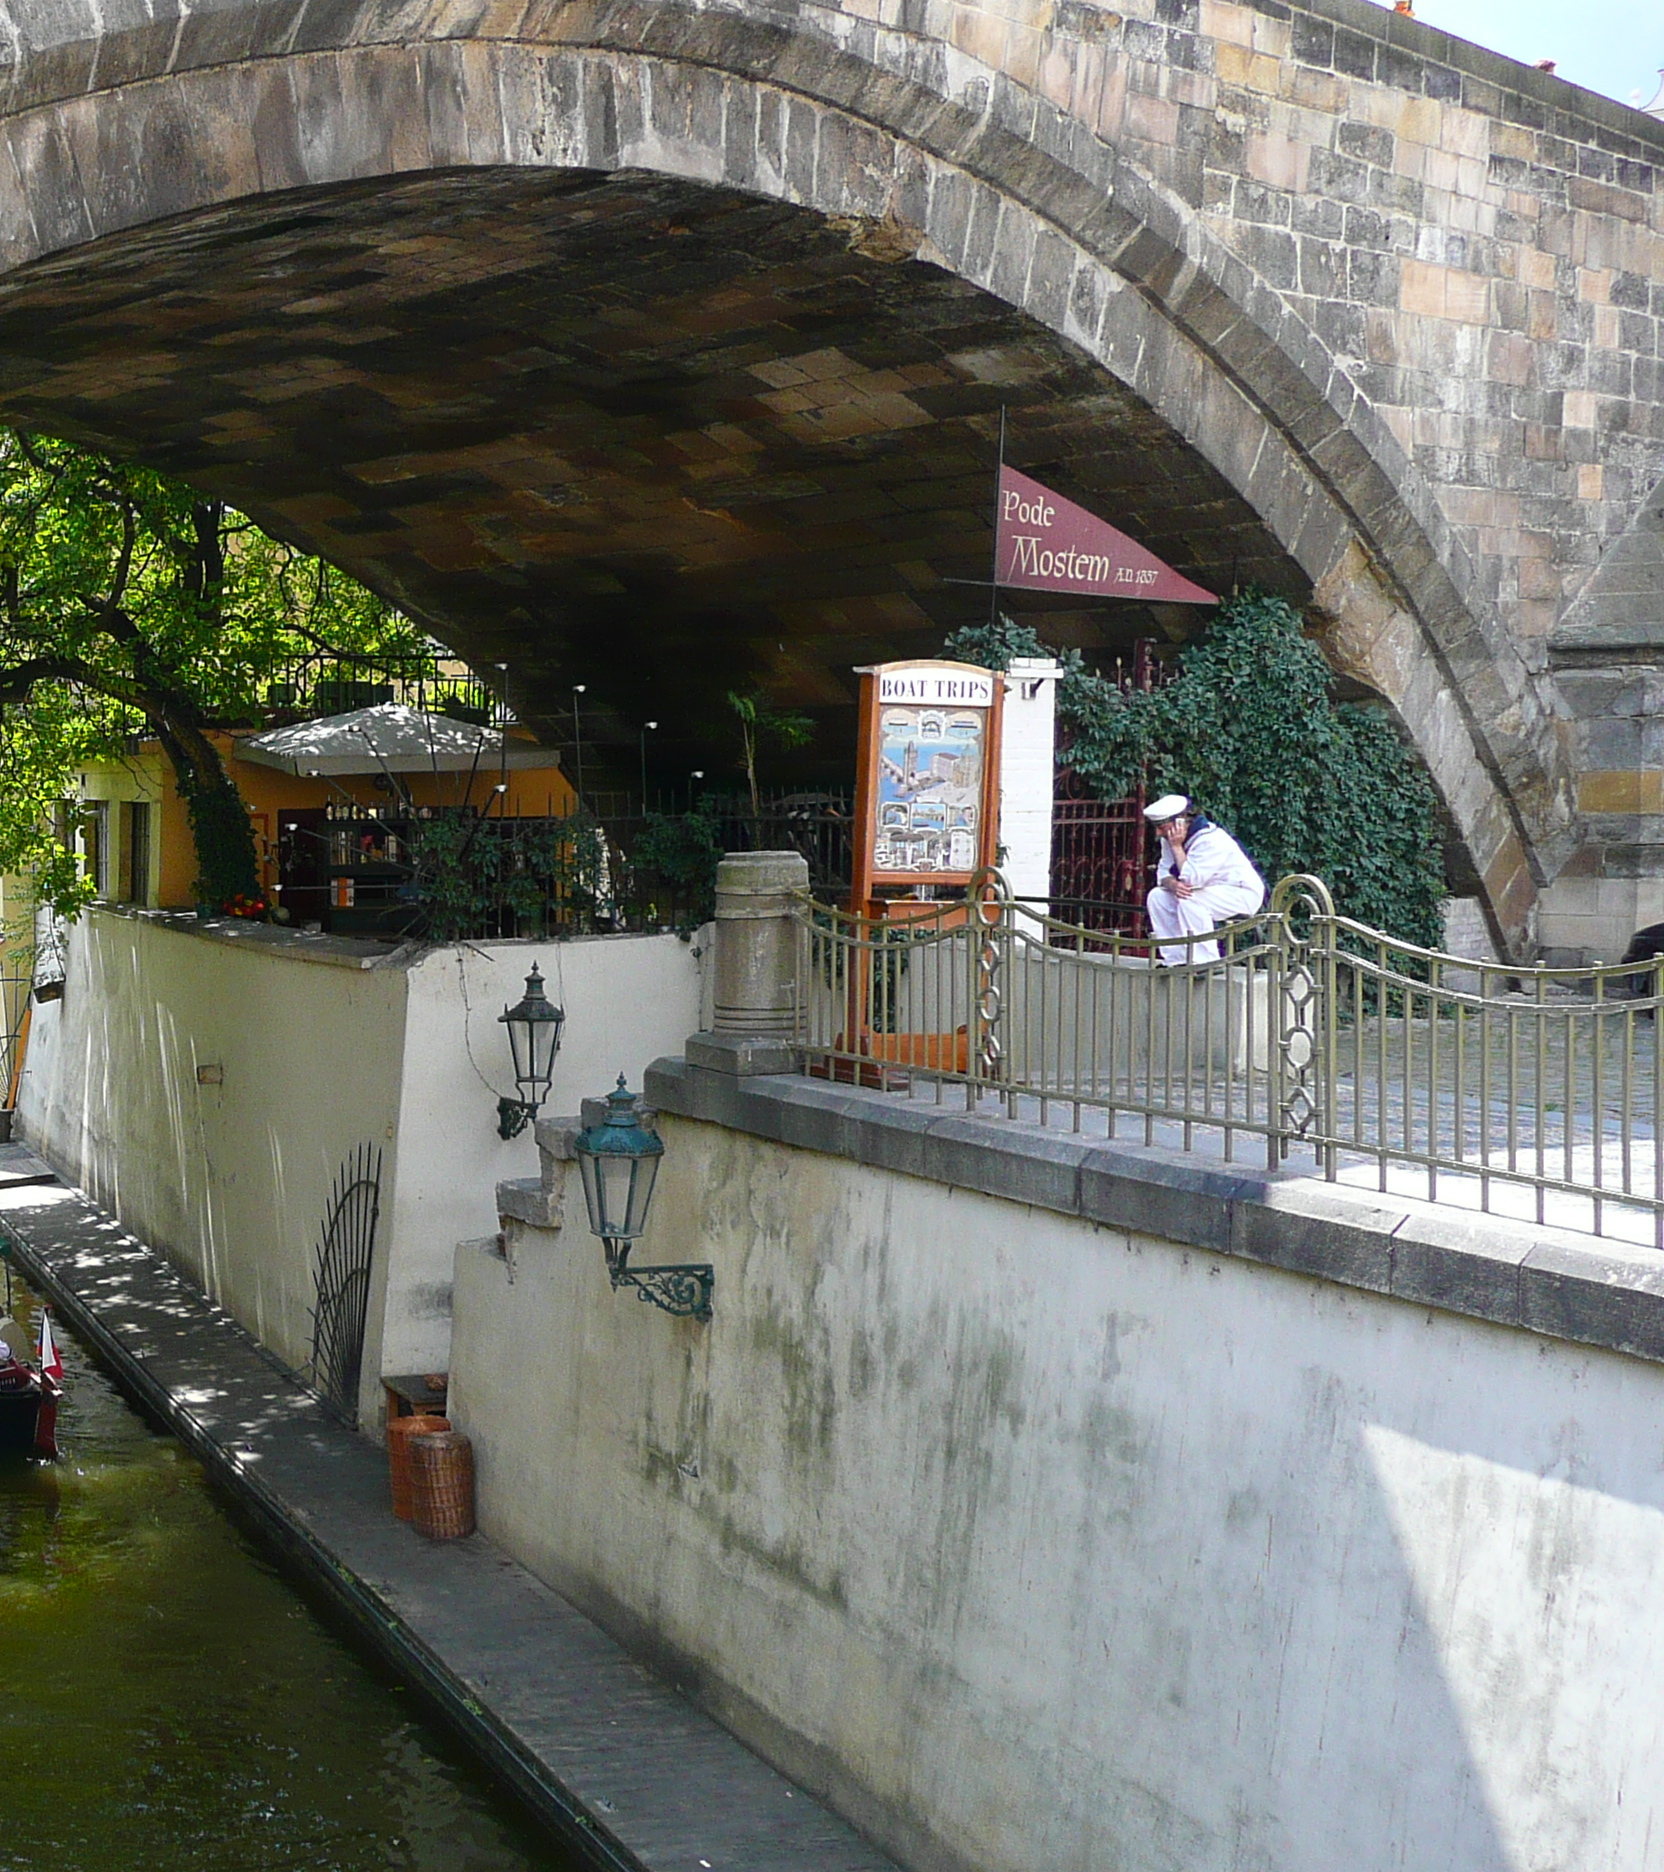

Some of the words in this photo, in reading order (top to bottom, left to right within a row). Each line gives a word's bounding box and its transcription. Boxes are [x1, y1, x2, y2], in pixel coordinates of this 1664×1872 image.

[1002, 490, 1055, 527] Pode
[1007, 535, 1109, 582] Mostem
[882, 679, 928, 698] BOAT
[934, 680, 989, 699] TRIPS
